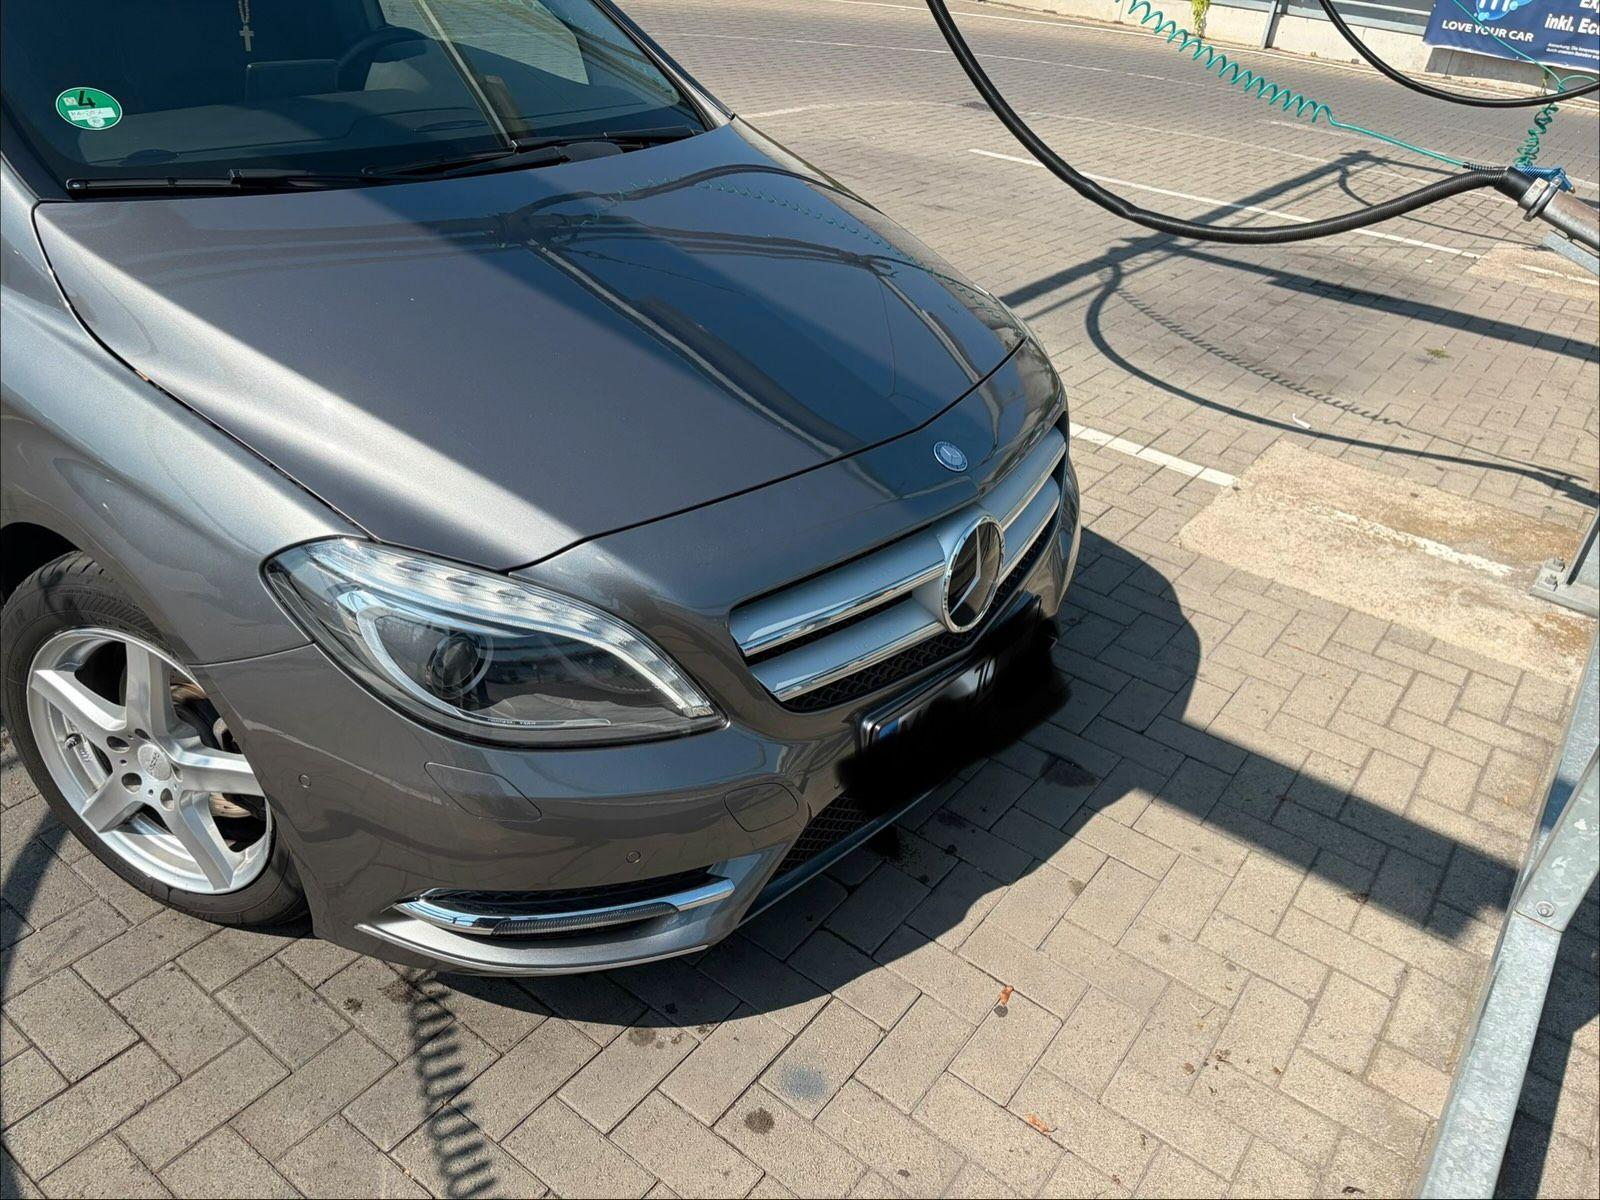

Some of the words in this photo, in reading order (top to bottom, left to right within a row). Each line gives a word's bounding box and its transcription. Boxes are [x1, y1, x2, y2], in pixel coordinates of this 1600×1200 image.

[1441, 20, 1473, 33] LOVE
[1474, 24, 1507, 38] YOUR
[1508, 30, 1534, 42] CAR
[1544, 13, 1574, 32] inkl.
[78, 89, 96, 108] 4
